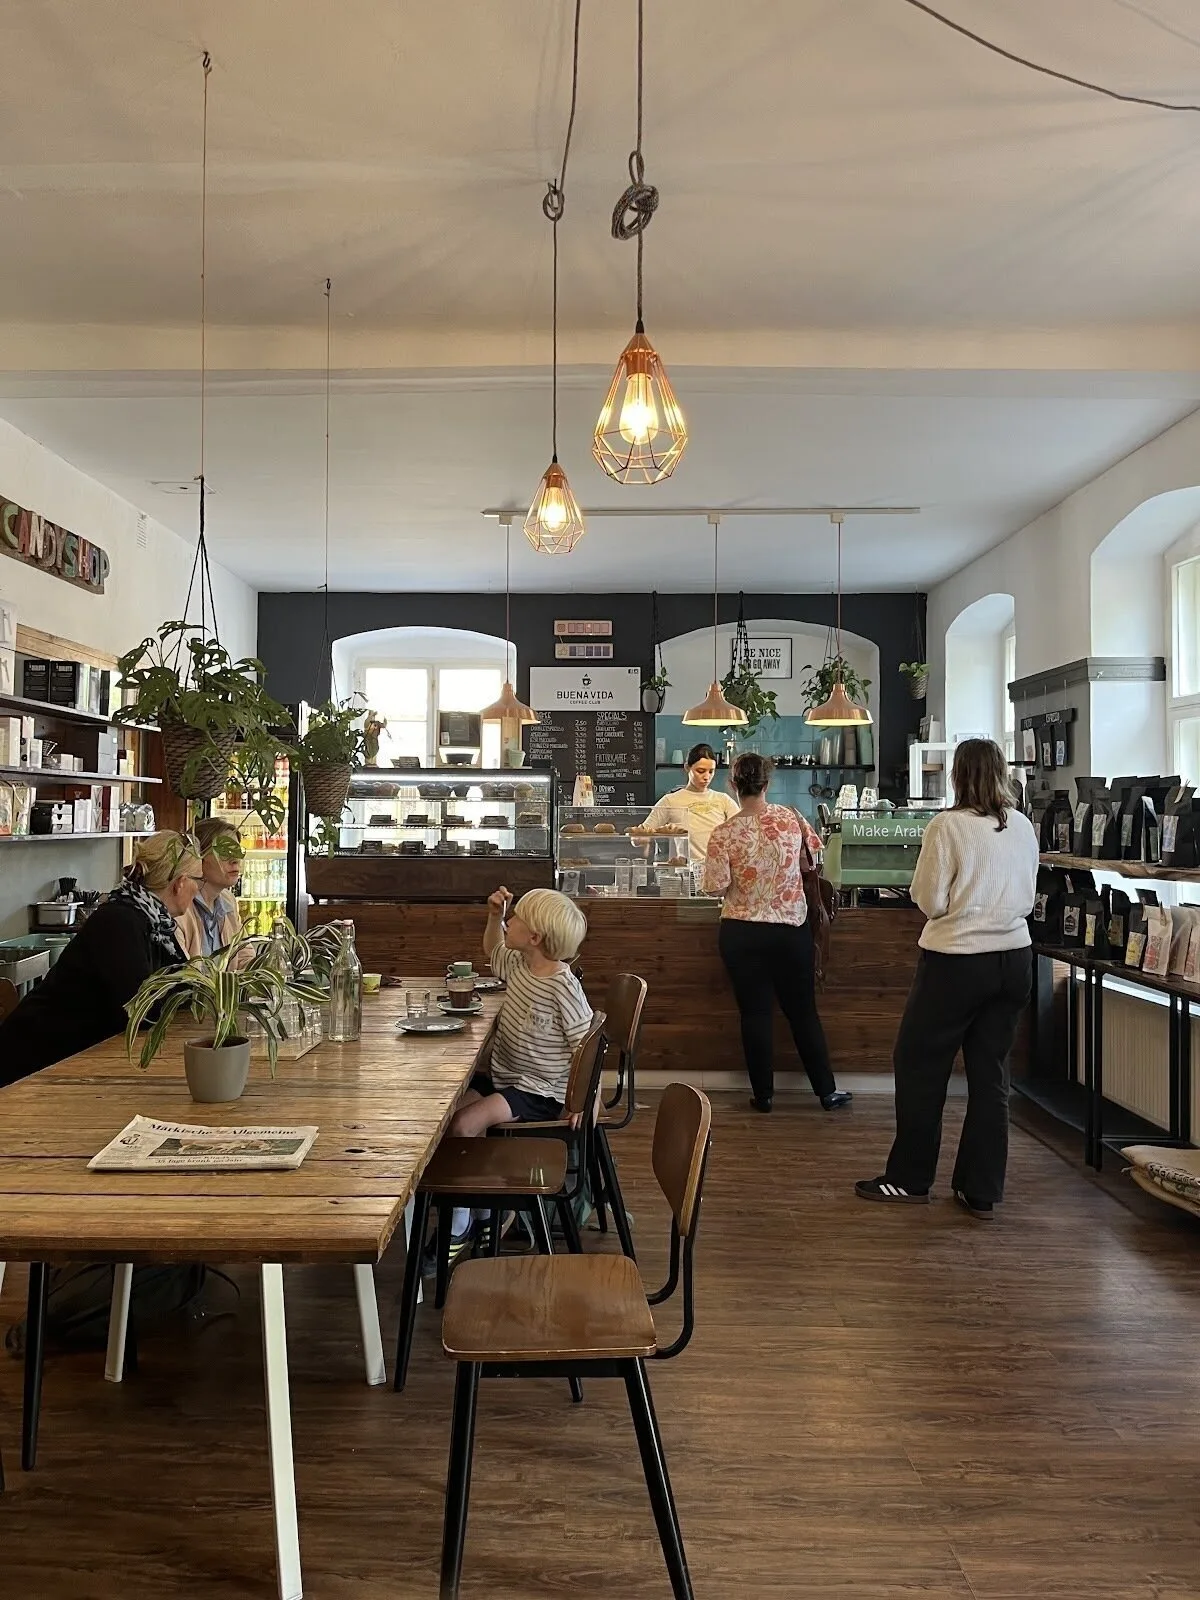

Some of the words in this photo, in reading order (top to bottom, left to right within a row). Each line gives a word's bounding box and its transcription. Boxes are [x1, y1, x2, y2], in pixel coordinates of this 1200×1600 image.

[758, 648, 781, 658] NICE
[762, 659, 781, 670] AWAY
[556, 690, 589, 700] BUENA
[590, 690, 614, 700] VIDA
[596, 711, 628, 721] SPECIALS
[852, 824, 890, 837] Make
